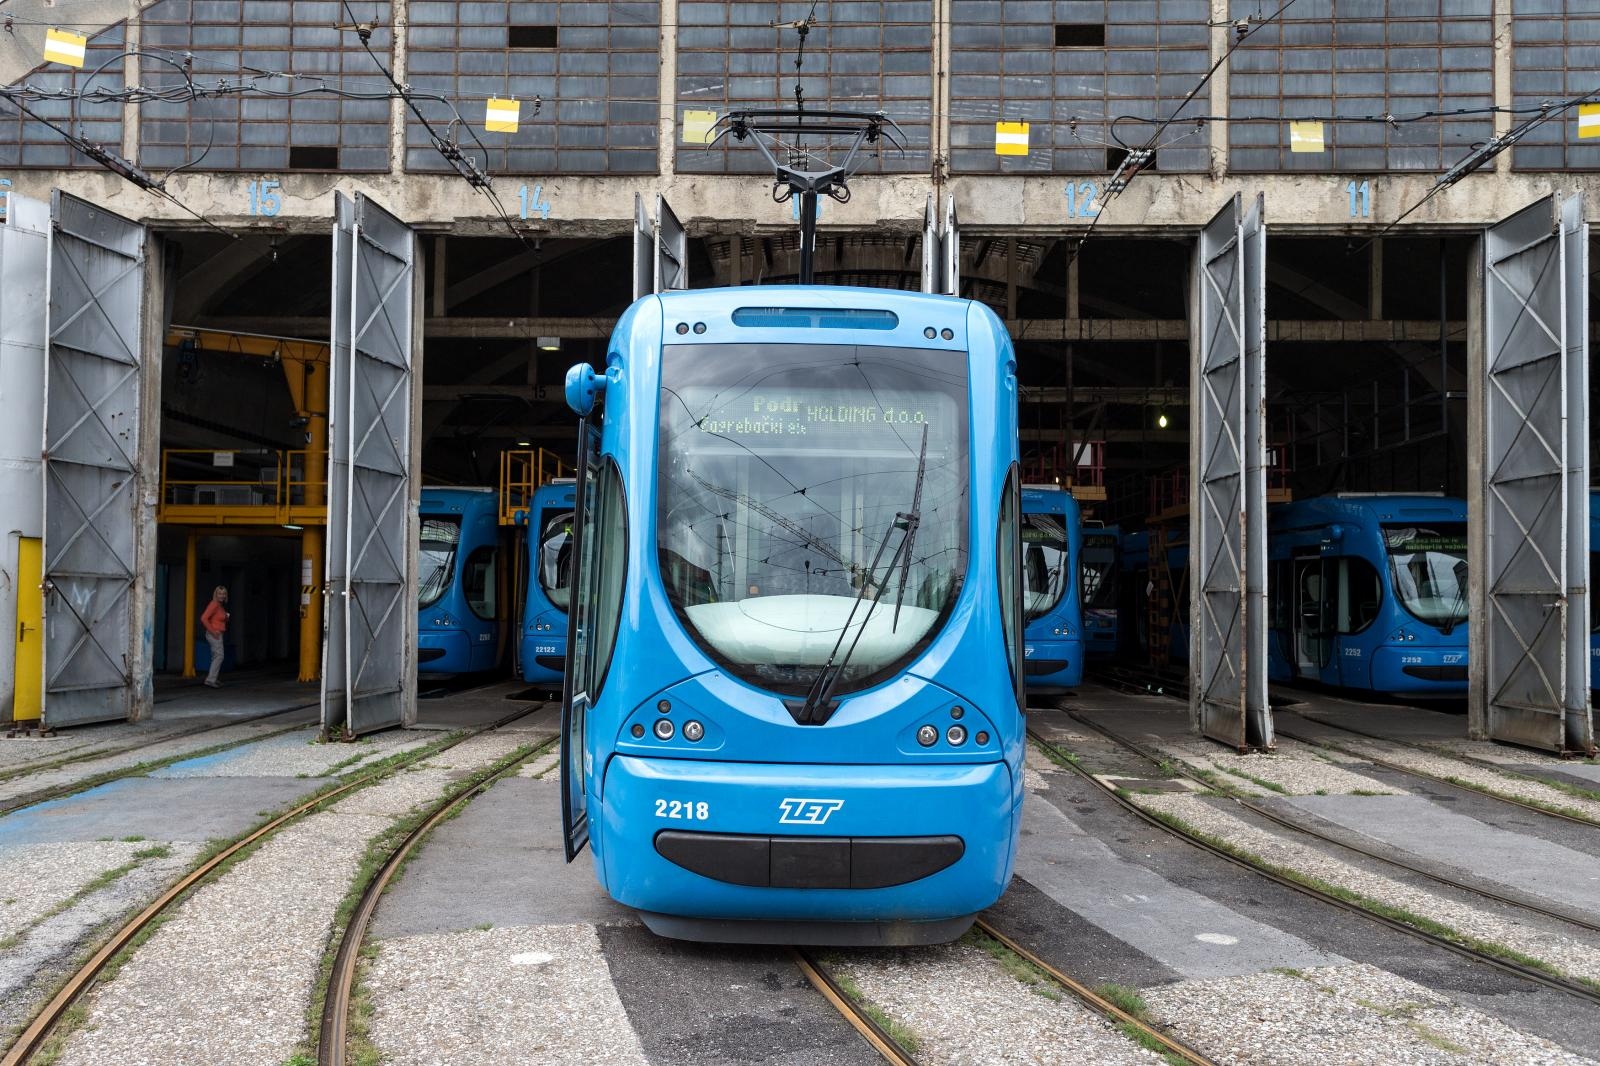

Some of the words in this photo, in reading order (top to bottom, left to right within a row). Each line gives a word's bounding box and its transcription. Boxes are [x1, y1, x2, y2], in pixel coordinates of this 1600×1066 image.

[247, 180, 281, 217] 15
[518, 184, 550, 219] 14
[1064, 181, 1098, 217] 12
[1346, 180, 1369, 217] 11
[1344, 647, 1361, 657] 2252
[655, 799, 709, 820] 2218
[778, 798, 845, 825] ZET
